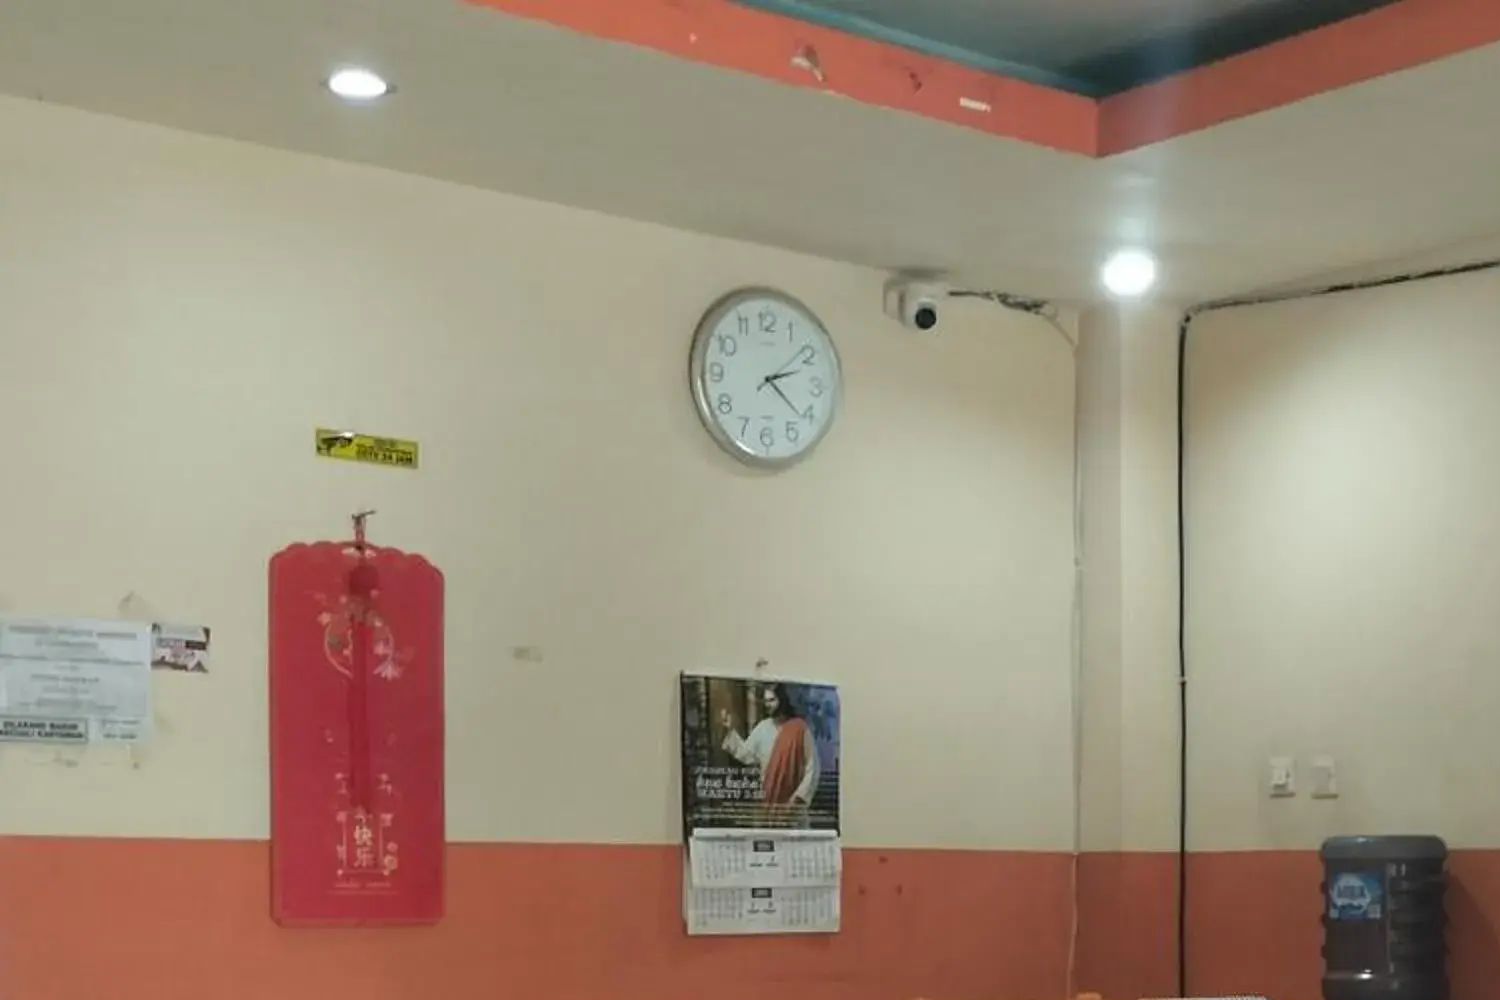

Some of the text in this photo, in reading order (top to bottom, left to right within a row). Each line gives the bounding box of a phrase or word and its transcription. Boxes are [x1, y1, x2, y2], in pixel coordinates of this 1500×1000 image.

[738, 315, 749, 336] 11
[758, 311, 777, 333] 12
[718, 334, 737, 357] 10
[801, 345, 815, 366] 2
[710, 362, 724, 382] 9
[809, 376, 823, 398] 3
[717, 393, 732, 414] 8
[803, 404, 814, 425] 4
[737, 416, 750, 437] 7
[760, 427, 774, 447] 6
[786, 421, 799, 442] 5
